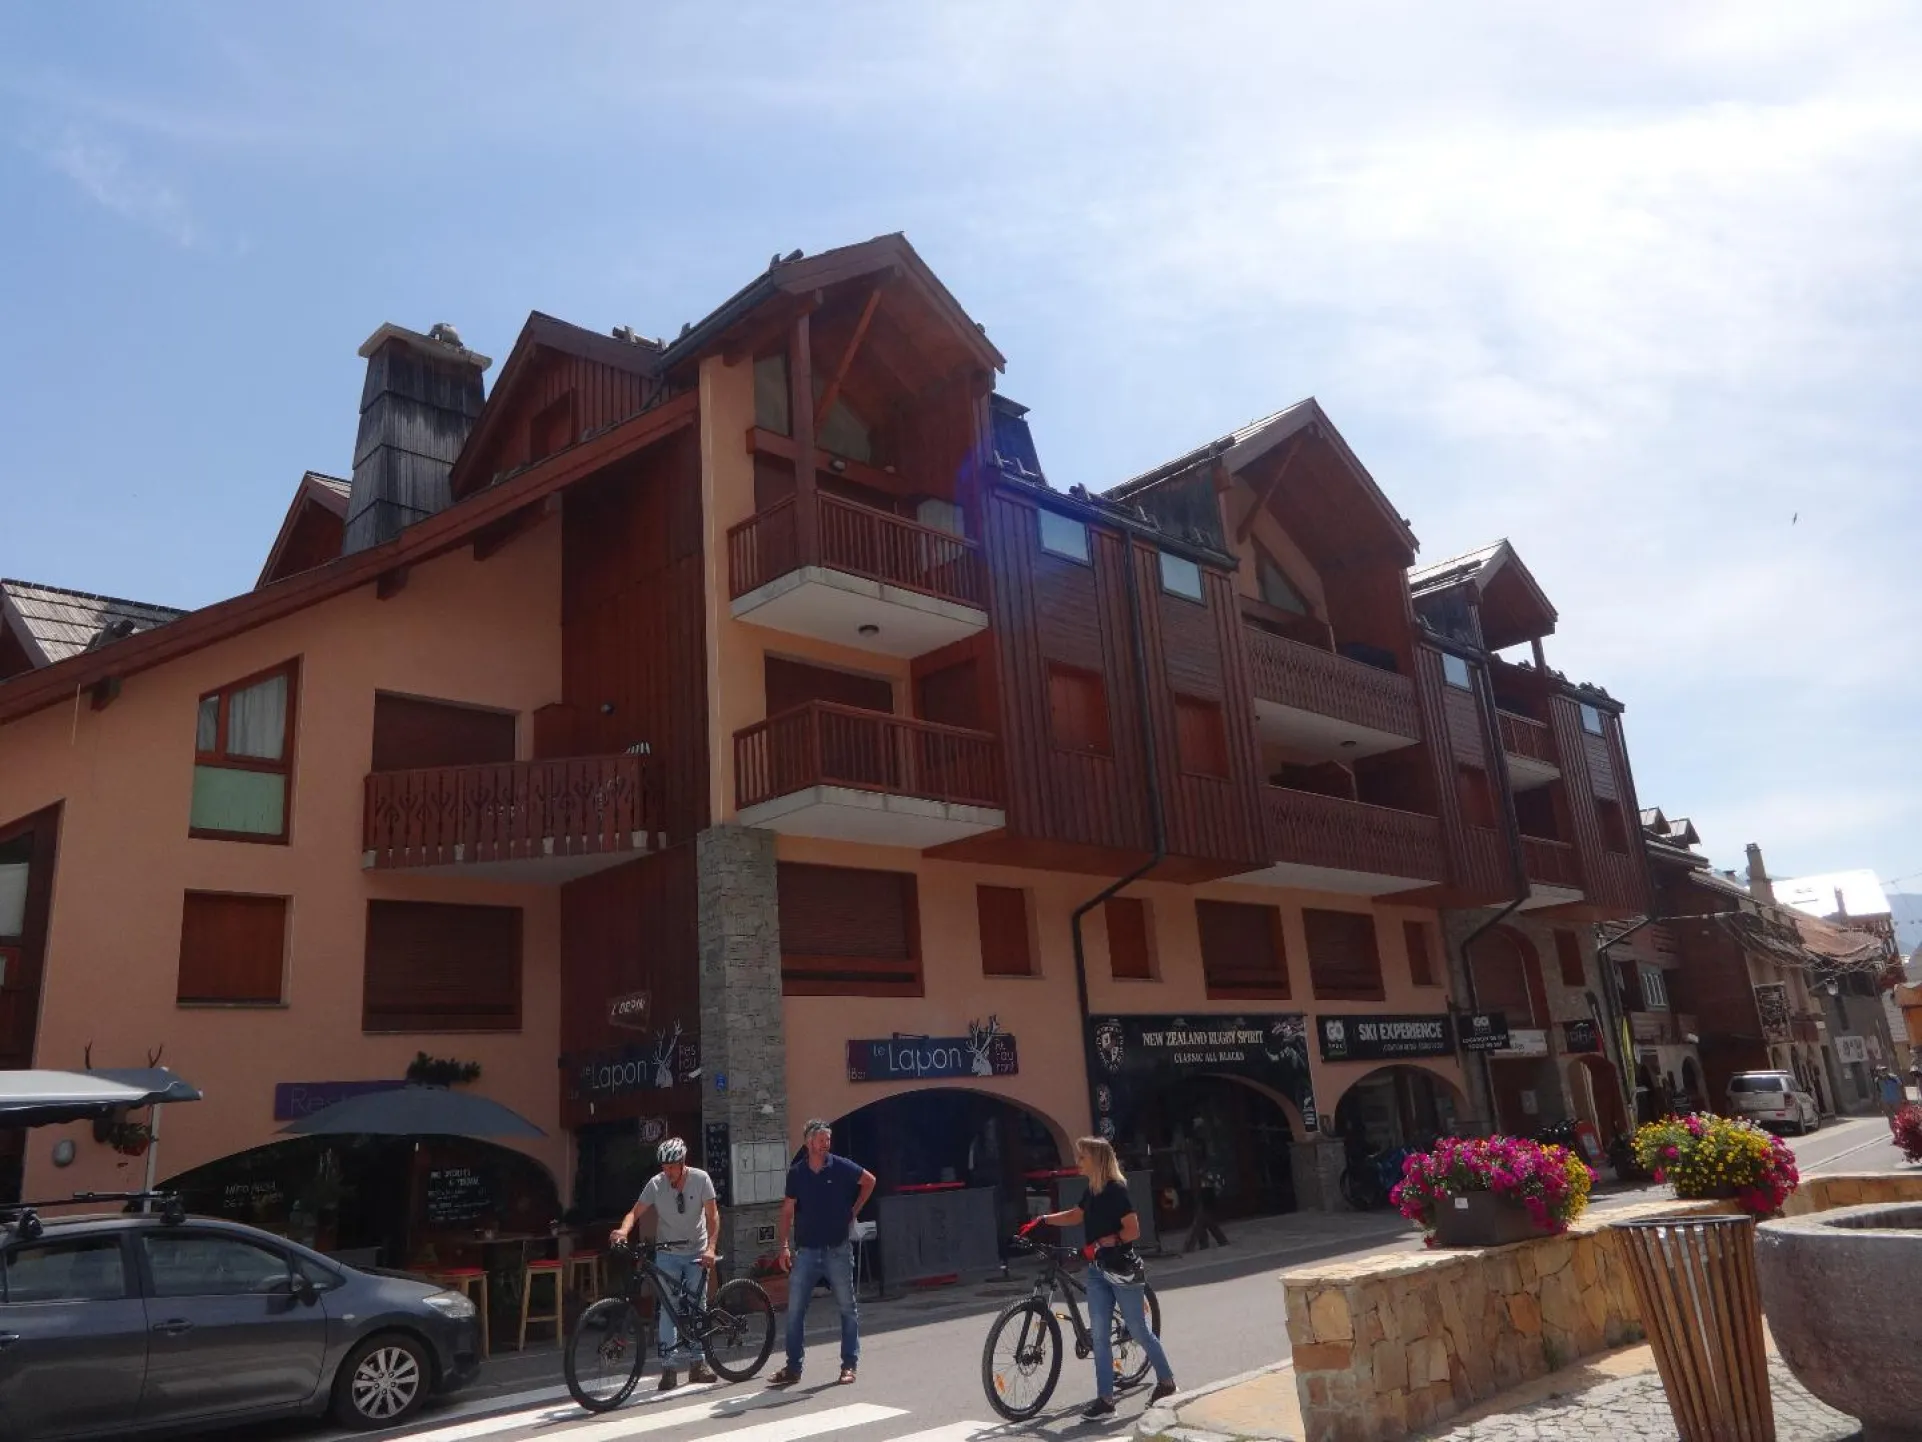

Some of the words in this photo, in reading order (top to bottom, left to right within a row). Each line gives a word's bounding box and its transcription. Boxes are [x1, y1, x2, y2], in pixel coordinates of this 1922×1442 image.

[1142, 1032, 1165, 1047] NEW
[1165, 1031, 1208, 1047] ZEALAND
[1208, 1031, 1236, 1046] RUGBY
[1236, 1030, 1264, 1045] SPIRIT
[1326, 1020, 1345, 1041] GO
[1358, 1022, 1378, 1041] SKI
[1379, 1021, 1443, 1040] EXPERIENCE
[888, 1043, 962, 1077] Lapon
[1173, 1051, 1204, 1064] CLASSIC
[1204, 1051, 1219, 1063] ALL
[1219, 1051, 1244, 1062] BLACKS
[592, 1060, 648, 1095] Lapon
